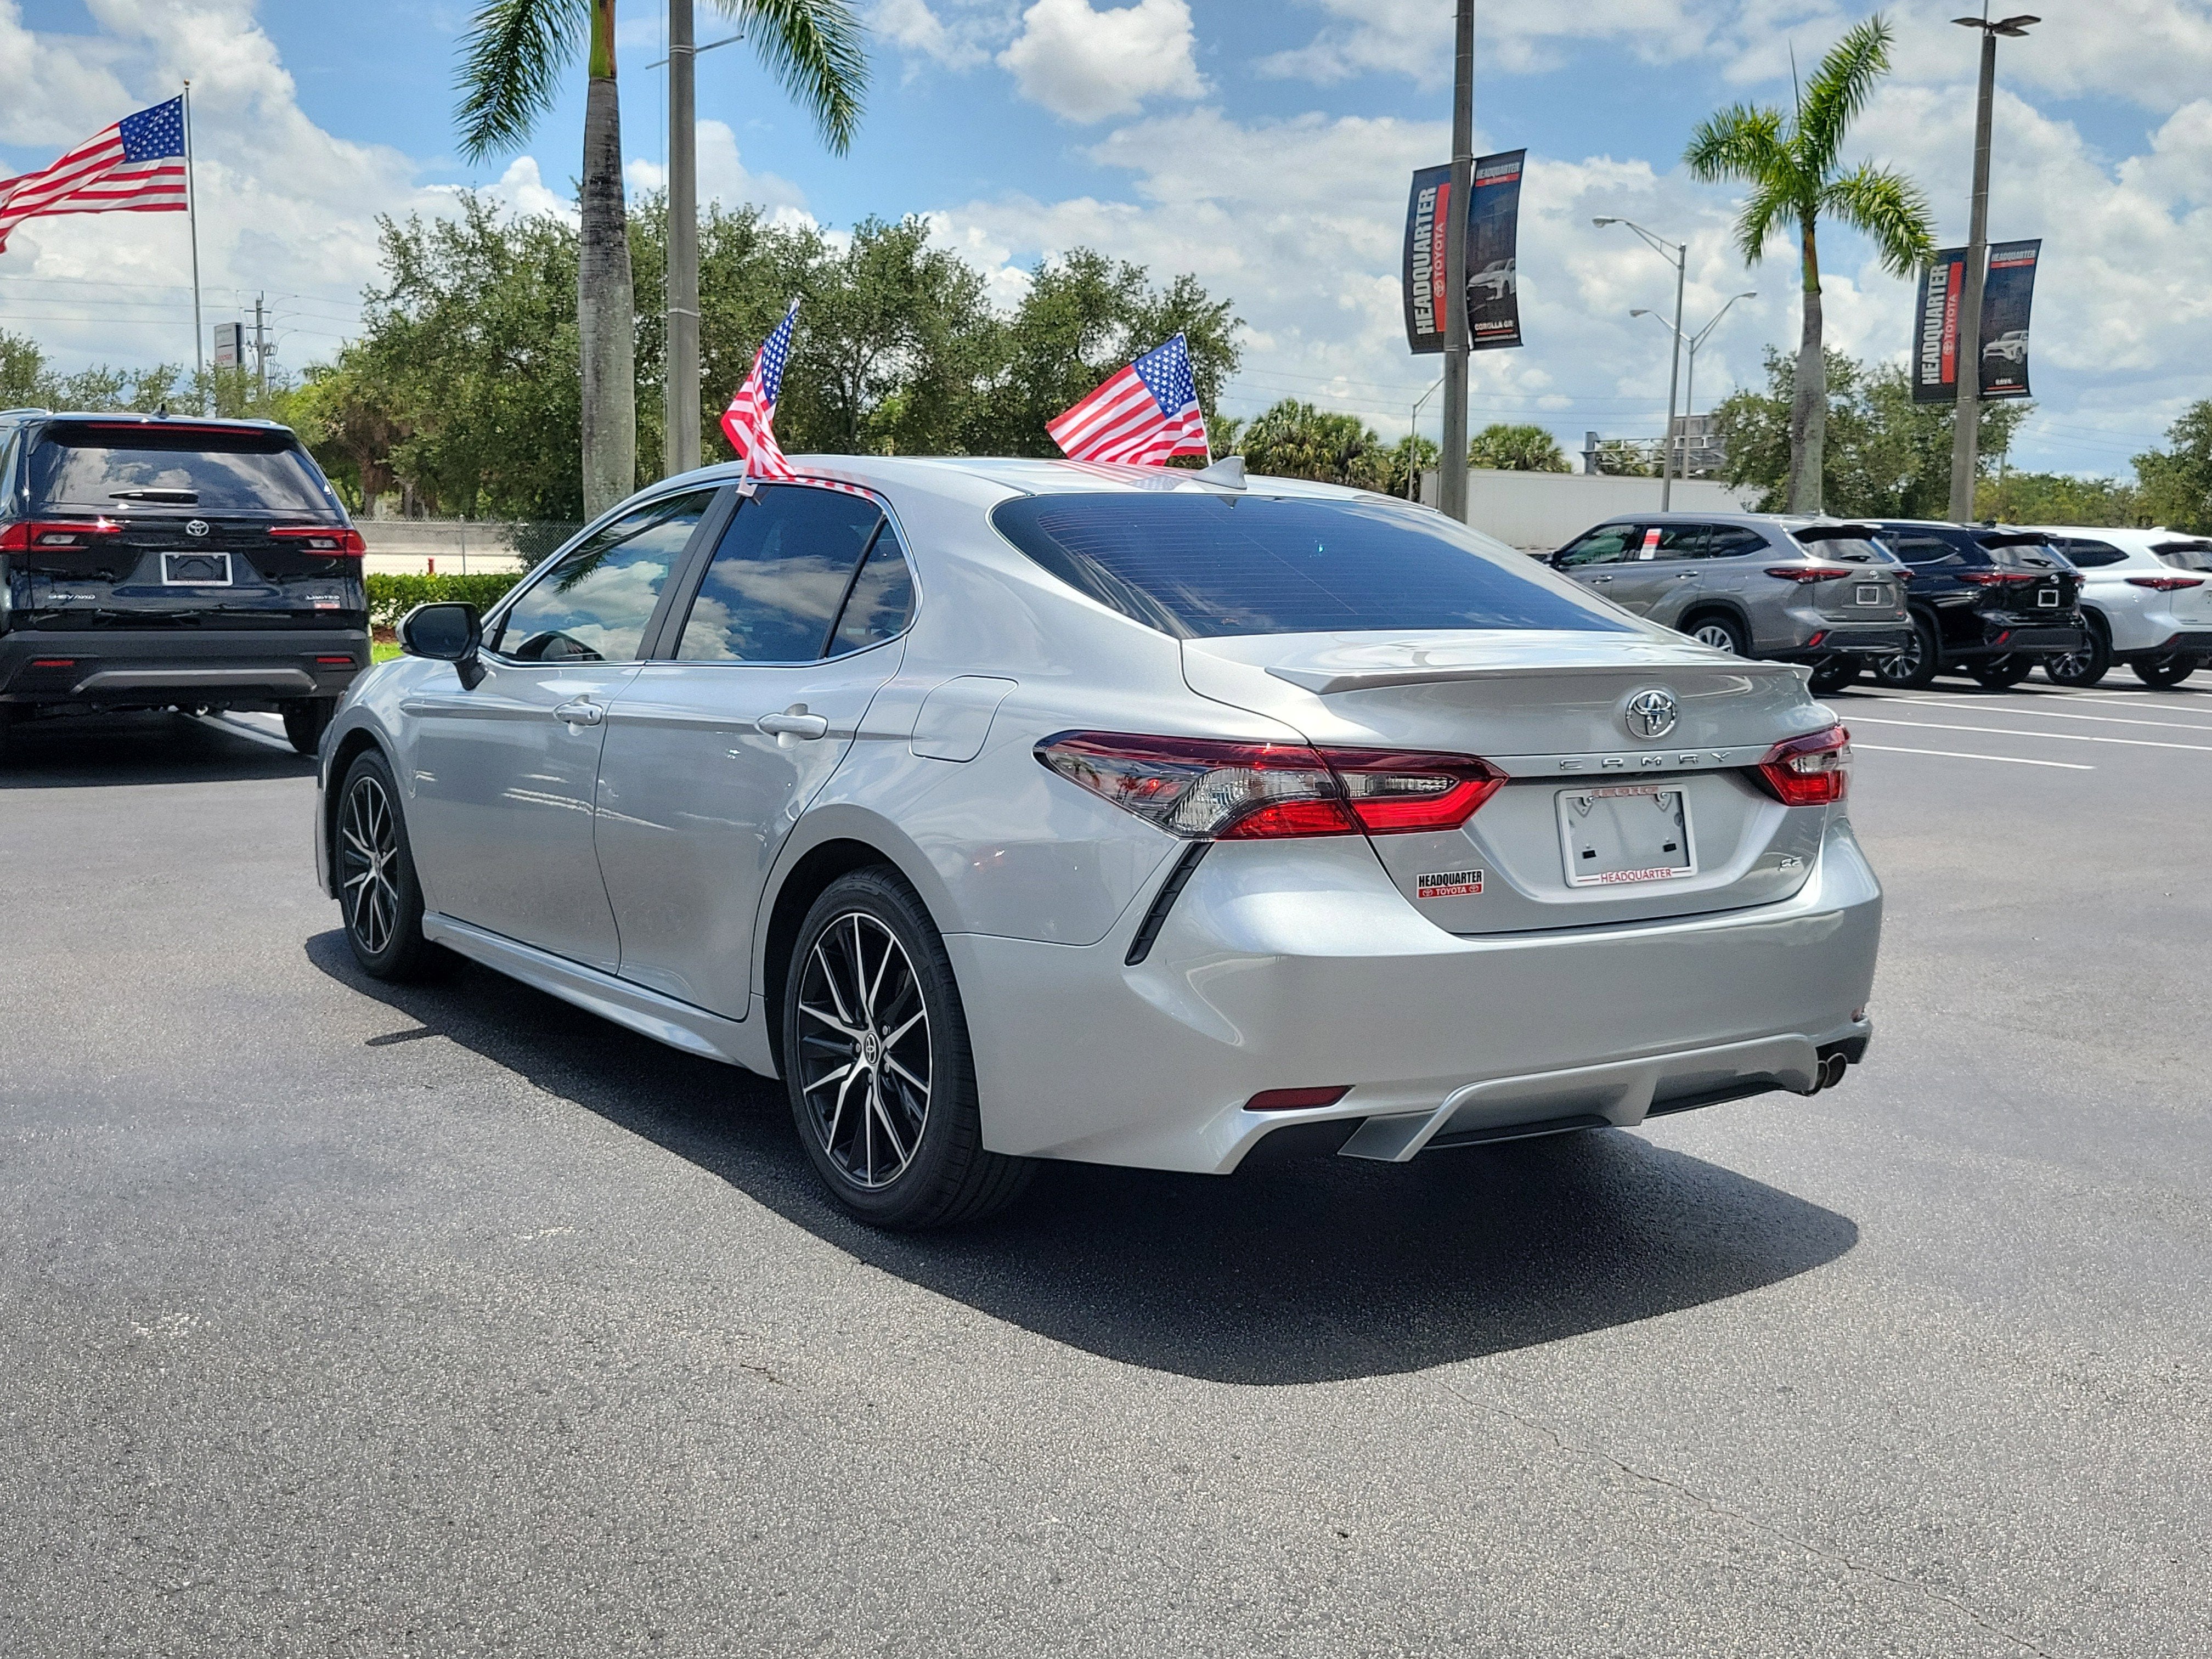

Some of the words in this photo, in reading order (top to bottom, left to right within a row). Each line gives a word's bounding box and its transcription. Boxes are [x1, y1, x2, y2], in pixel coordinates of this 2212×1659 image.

[1412, 187, 1437, 335] HEADQUARTER
[1434, 222, 1444, 279] TOYOTA
[1922, 264, 1949, 385] HEADQUARTER
[1944, 294, 1959, 341] TOYOTA
[1560, 752, 1730, 770] CAMRY
[1419, 871, 1482, 887] HEADQUARTER
[1436, 887, 1466, 895] TOYOTA
[1601, 868, 1672, 883] HEADQUARTER
